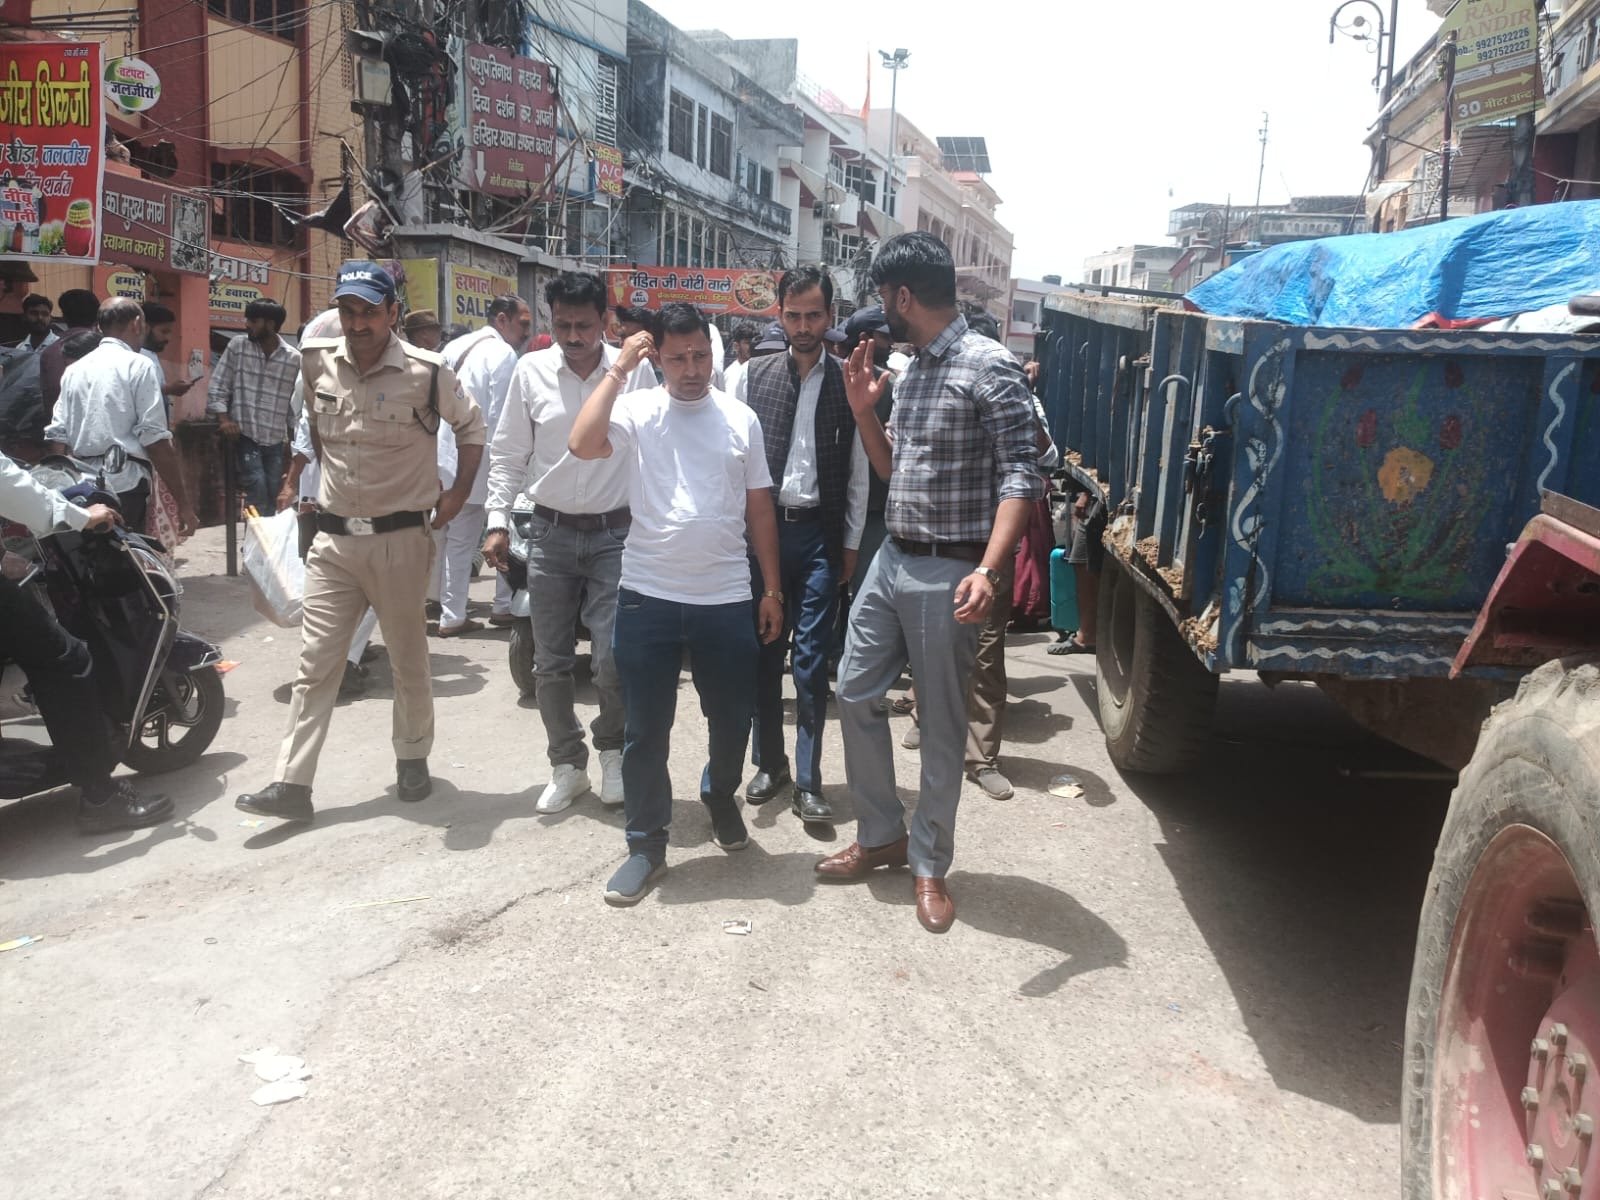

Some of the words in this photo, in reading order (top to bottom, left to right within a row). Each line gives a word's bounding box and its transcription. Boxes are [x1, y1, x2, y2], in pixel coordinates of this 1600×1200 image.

[1465, 0, 1508, 23] RAJ
[1476, 27, 1530, 50] 9927522226
[1477, 40, 1530, 62] 9927522227
[470, 54, 512, 85] पशुपतिनाथ
[518, 67, 542, 91] महादेव
[35, 60, 90, 126] शिकंजी
[110, 82, 154, 99] जलजीरा
[471, 87, 490, 113] दिव्य
[496, 94, 515, 119] दर्शन
[520, 104, 531, 123] कर
[535, 105, 553, 129] अपनी
[1458, 100, 1480, 117] 30
[472, 118, 498, 147] हरिद्वार
[500, 130, 516, 149] यात्रा
[517, 133, 534, 152] सफल
[601, 163, 623, 177] A/C
[105, 190, 119, 213] का
[122, 193, 144, 231] मुख्य
[146, 194, 165, 225] मार्ग
[103, 234, 133, 253] स्वागत
[134, 240, 157, 257] करता
[341, 272, 372, 283] POLICE
[662, 273, 677, 289] जी
[681, 273, 704, 290] चोटी
[707, 275, 732, 292] वाले
